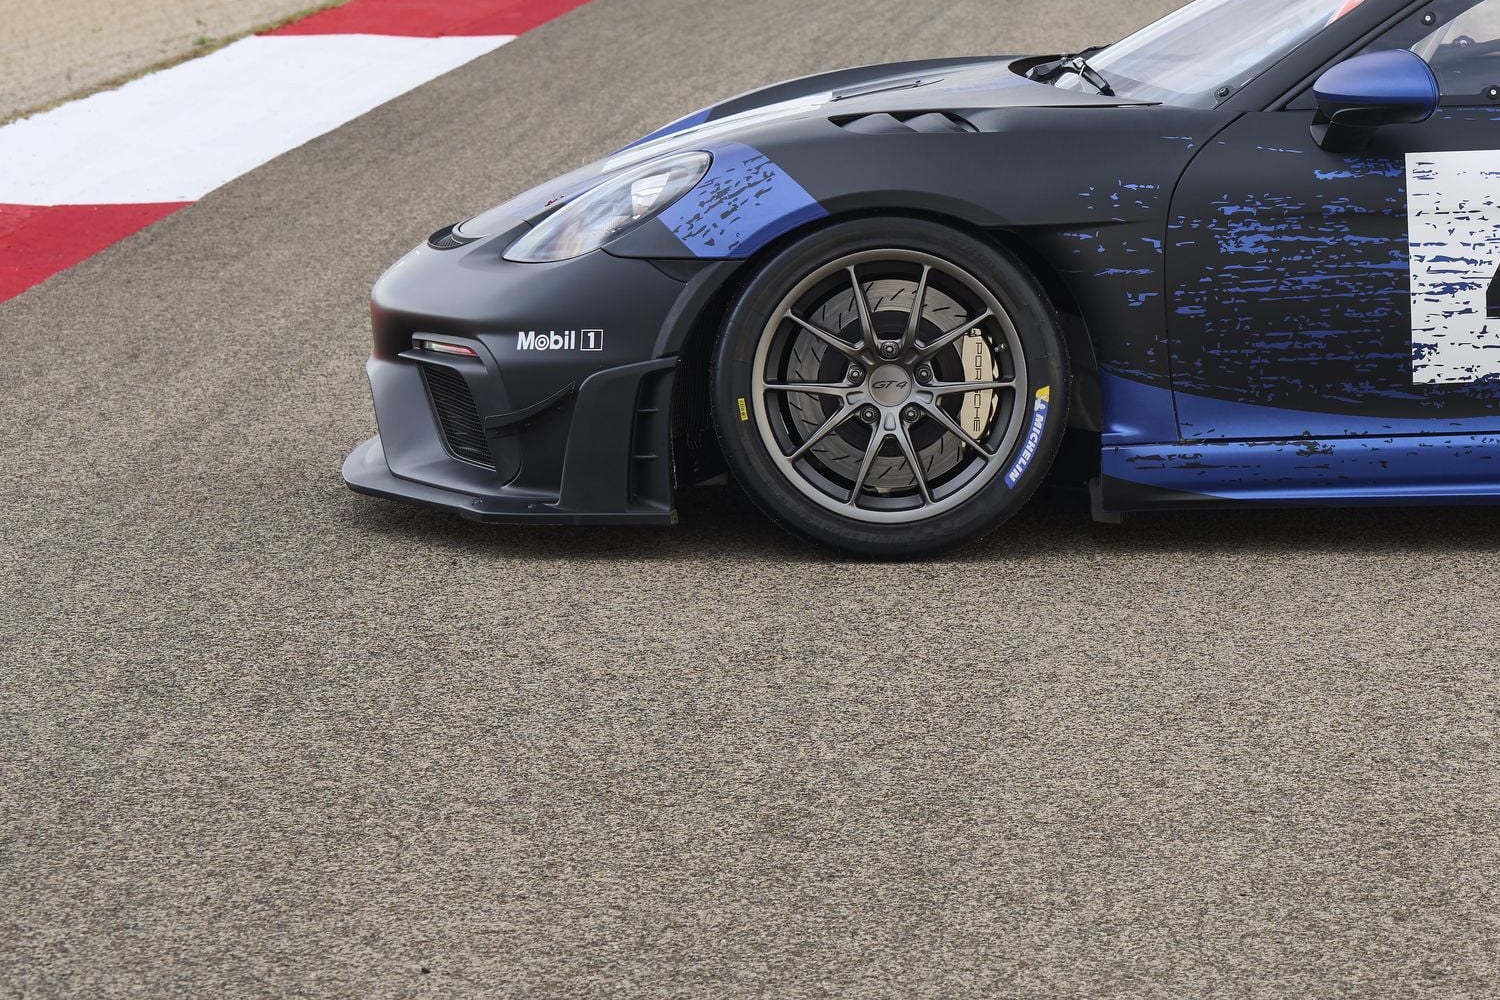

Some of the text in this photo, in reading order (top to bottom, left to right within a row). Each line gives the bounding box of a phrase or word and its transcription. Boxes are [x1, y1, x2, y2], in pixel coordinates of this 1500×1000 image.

[517, 330, 576, 351] Mobil
[872, 380, 908, 389] GT4
[973, 342, 983, 432] PORCHE
[1008, 414, 1044, 483] MICHELIN
